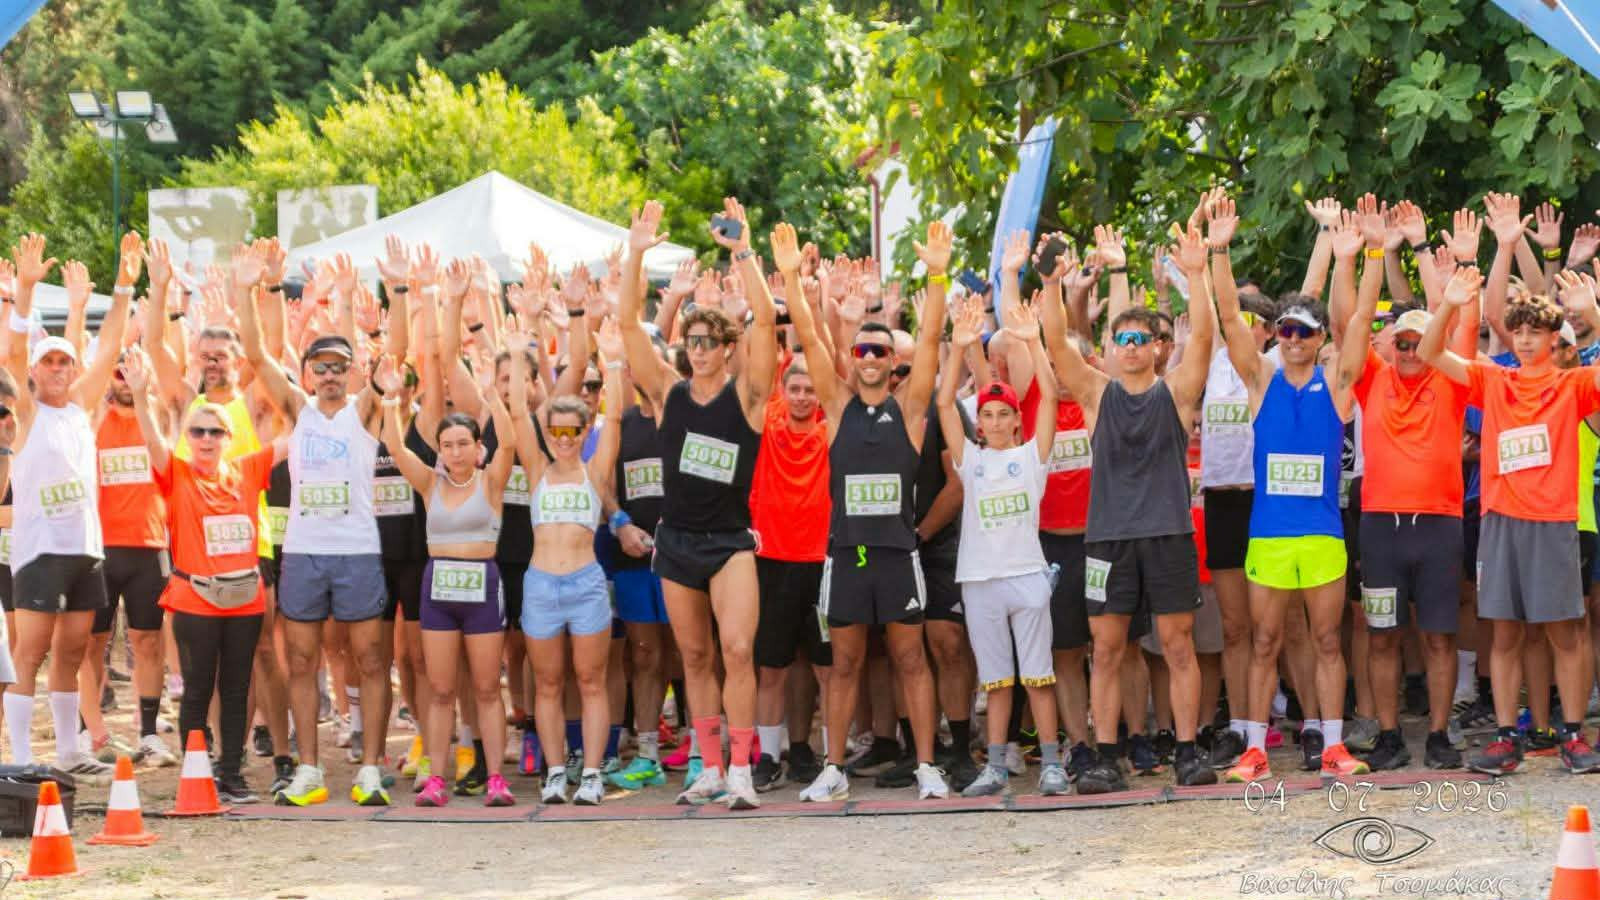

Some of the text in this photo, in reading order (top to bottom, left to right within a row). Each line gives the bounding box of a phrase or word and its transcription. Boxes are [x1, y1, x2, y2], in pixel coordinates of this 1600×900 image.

[688, 442, 730, 468] 5090
[1502, 436, 1544, 459] 5070
[1273, 462, 1318, 480] 5025
[302, 488, 345, 504] 5053
[851, 484, 896, 501] 5109
[983, 494, 1026, 516] 5050
[213, 522, 252, 541] 5055
[438, 570, 479, 589] 5092
